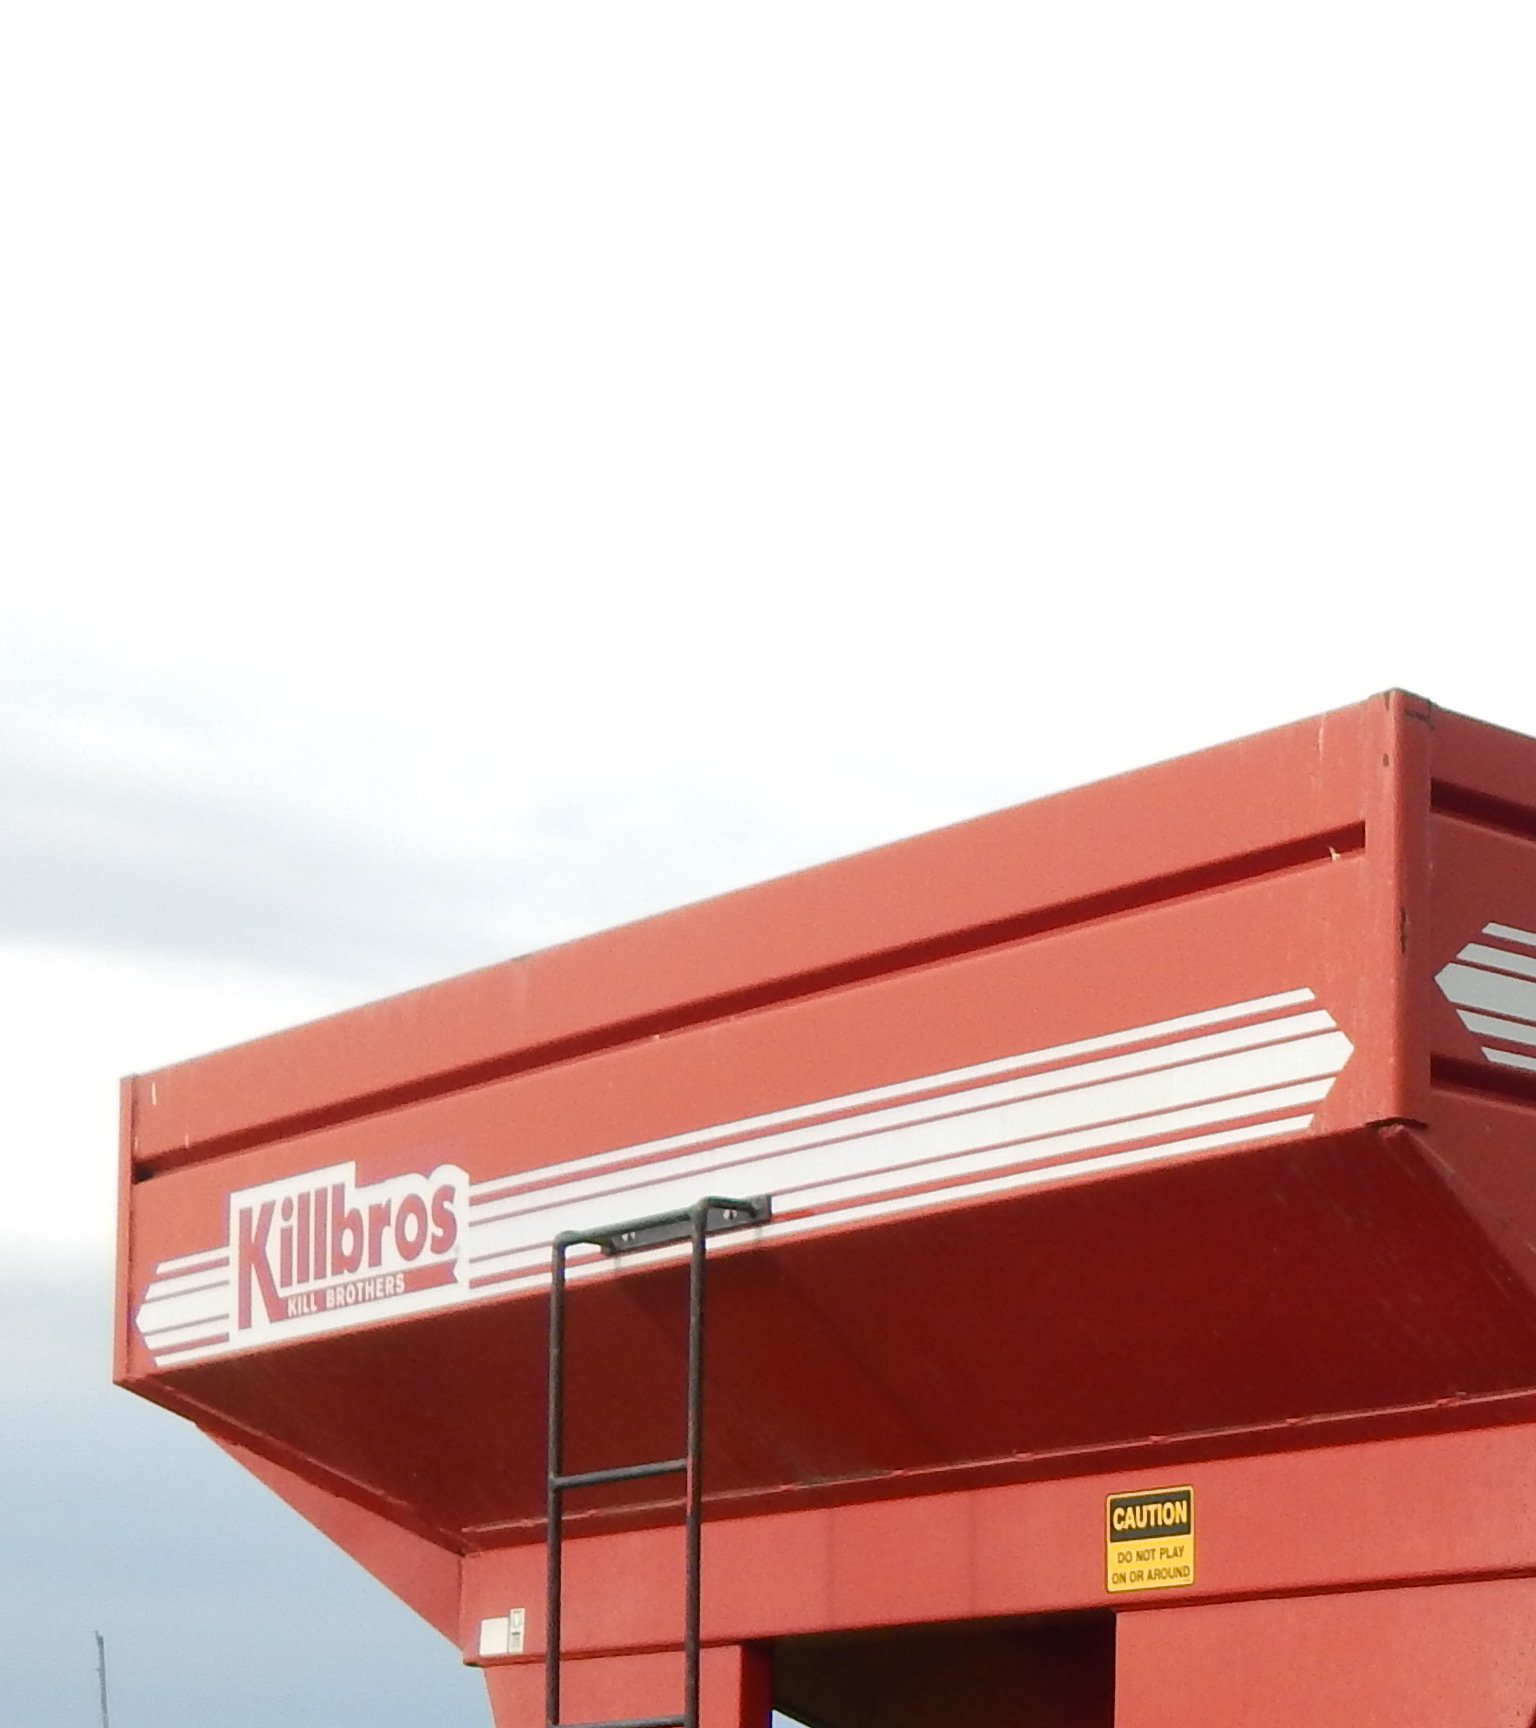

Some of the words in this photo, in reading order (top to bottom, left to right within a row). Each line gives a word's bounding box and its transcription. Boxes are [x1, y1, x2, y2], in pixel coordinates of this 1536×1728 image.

[238, 1183, 458, 1330] Killbros
[287, 1293, 318, 1318] KILL
[325, 1273, 405, 1309] BROTHERS
[1112, 1500, 1187, 1531] CAUTION
[1118, 1551, 1133, 1564] DO
[1136, 1548, 1155, 1562] NOT
[1159, 1545, 1184, 1560] PLAY
[1112, 1572, 1127, 1585] ON
[1129, 1569, 1144, 1582] OR
[1147, 1565, 1190, 1580] AROUND
